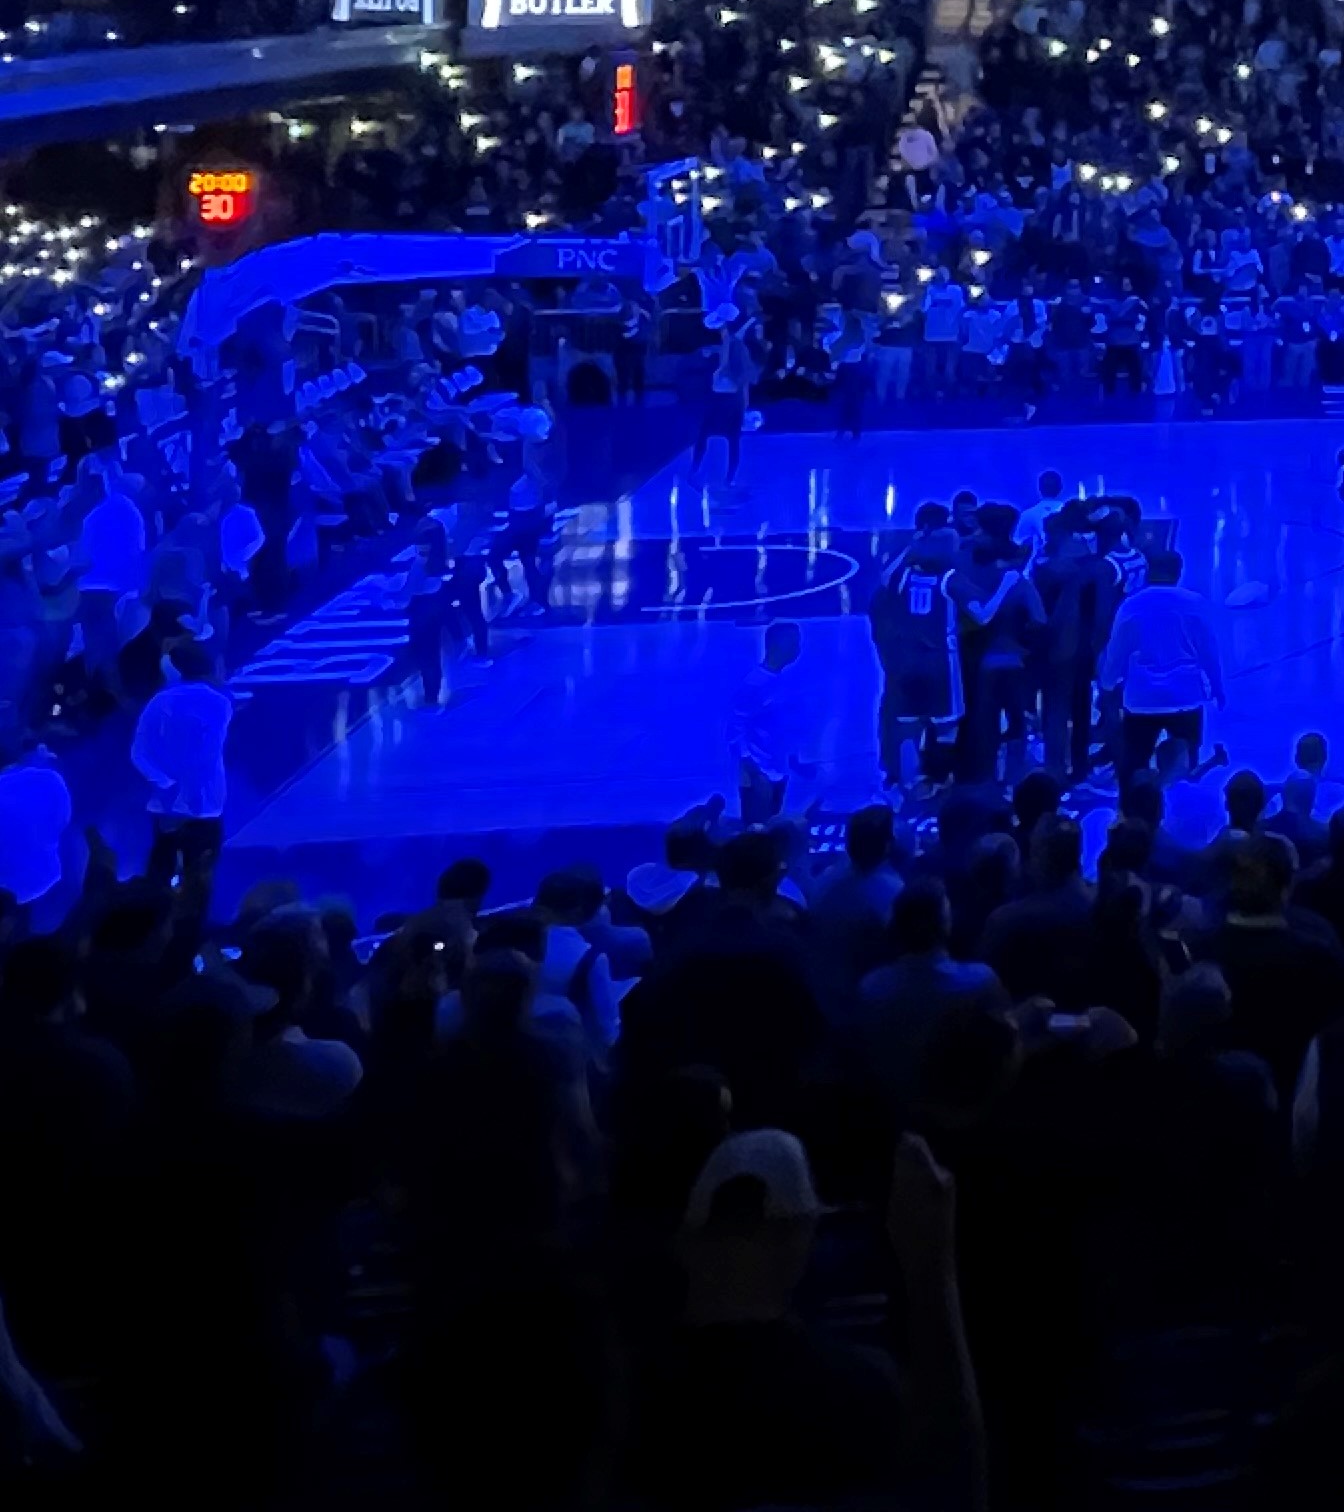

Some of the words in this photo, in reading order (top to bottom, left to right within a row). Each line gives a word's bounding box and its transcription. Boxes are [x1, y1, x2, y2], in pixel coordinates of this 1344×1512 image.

[189, 173, 246, 193] 20:00
[201, 194, 233, 220] 30
[557, 248, 618, 271] PNC
